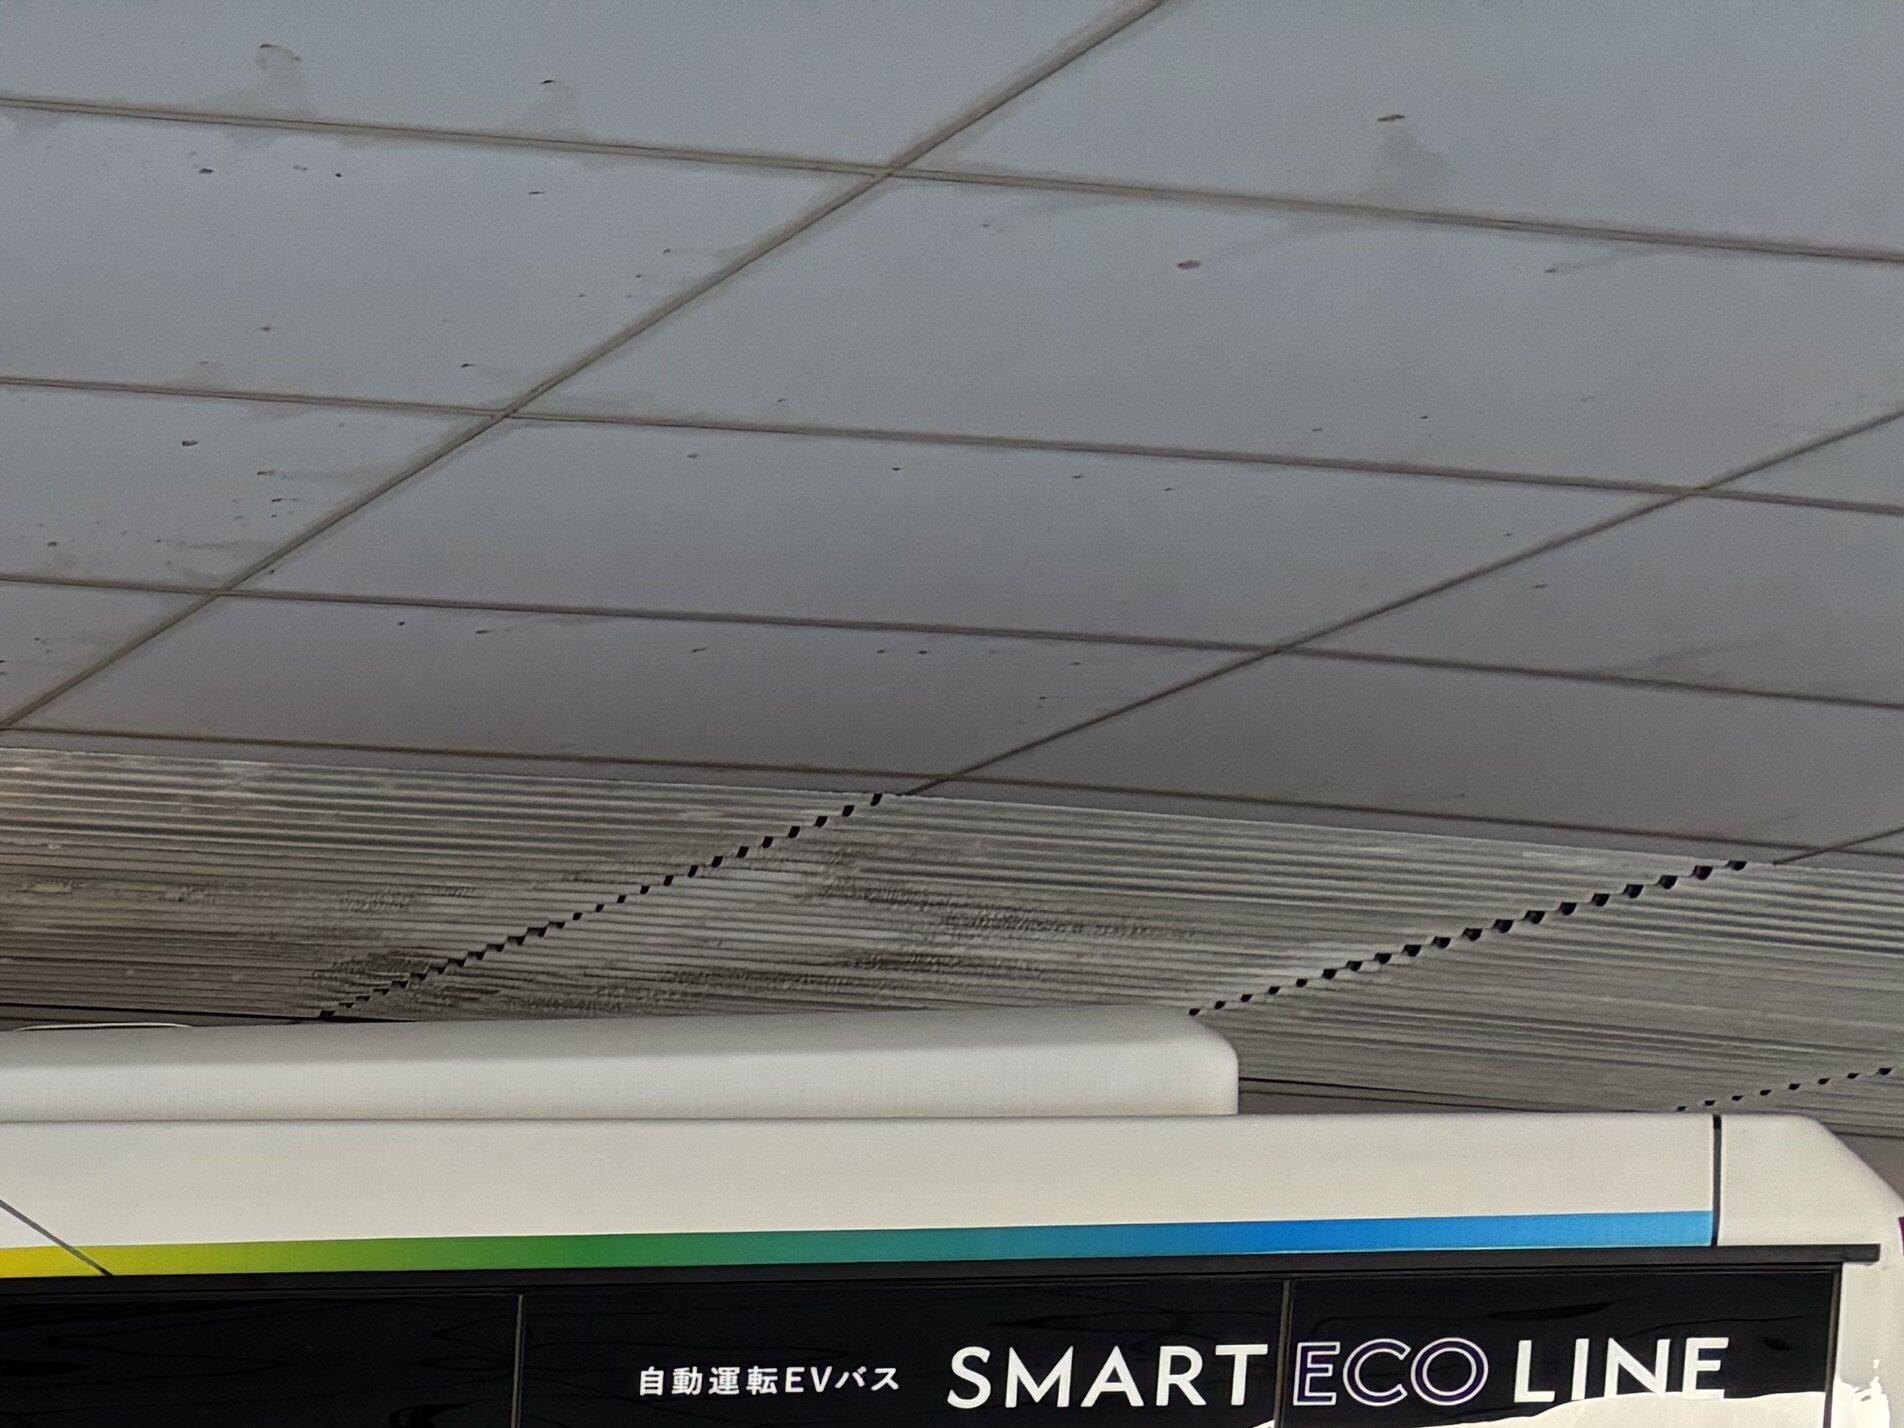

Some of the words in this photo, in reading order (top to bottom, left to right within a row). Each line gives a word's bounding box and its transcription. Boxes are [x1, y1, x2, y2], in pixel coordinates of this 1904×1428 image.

[638, 1365, 900, 1396] 自動運転EVバス
[947, 1344, 1269, 1409] SMART
[1293, 1337, 1489, 1407] ECO
[1513, 1337, 1730, 1403] LINE
